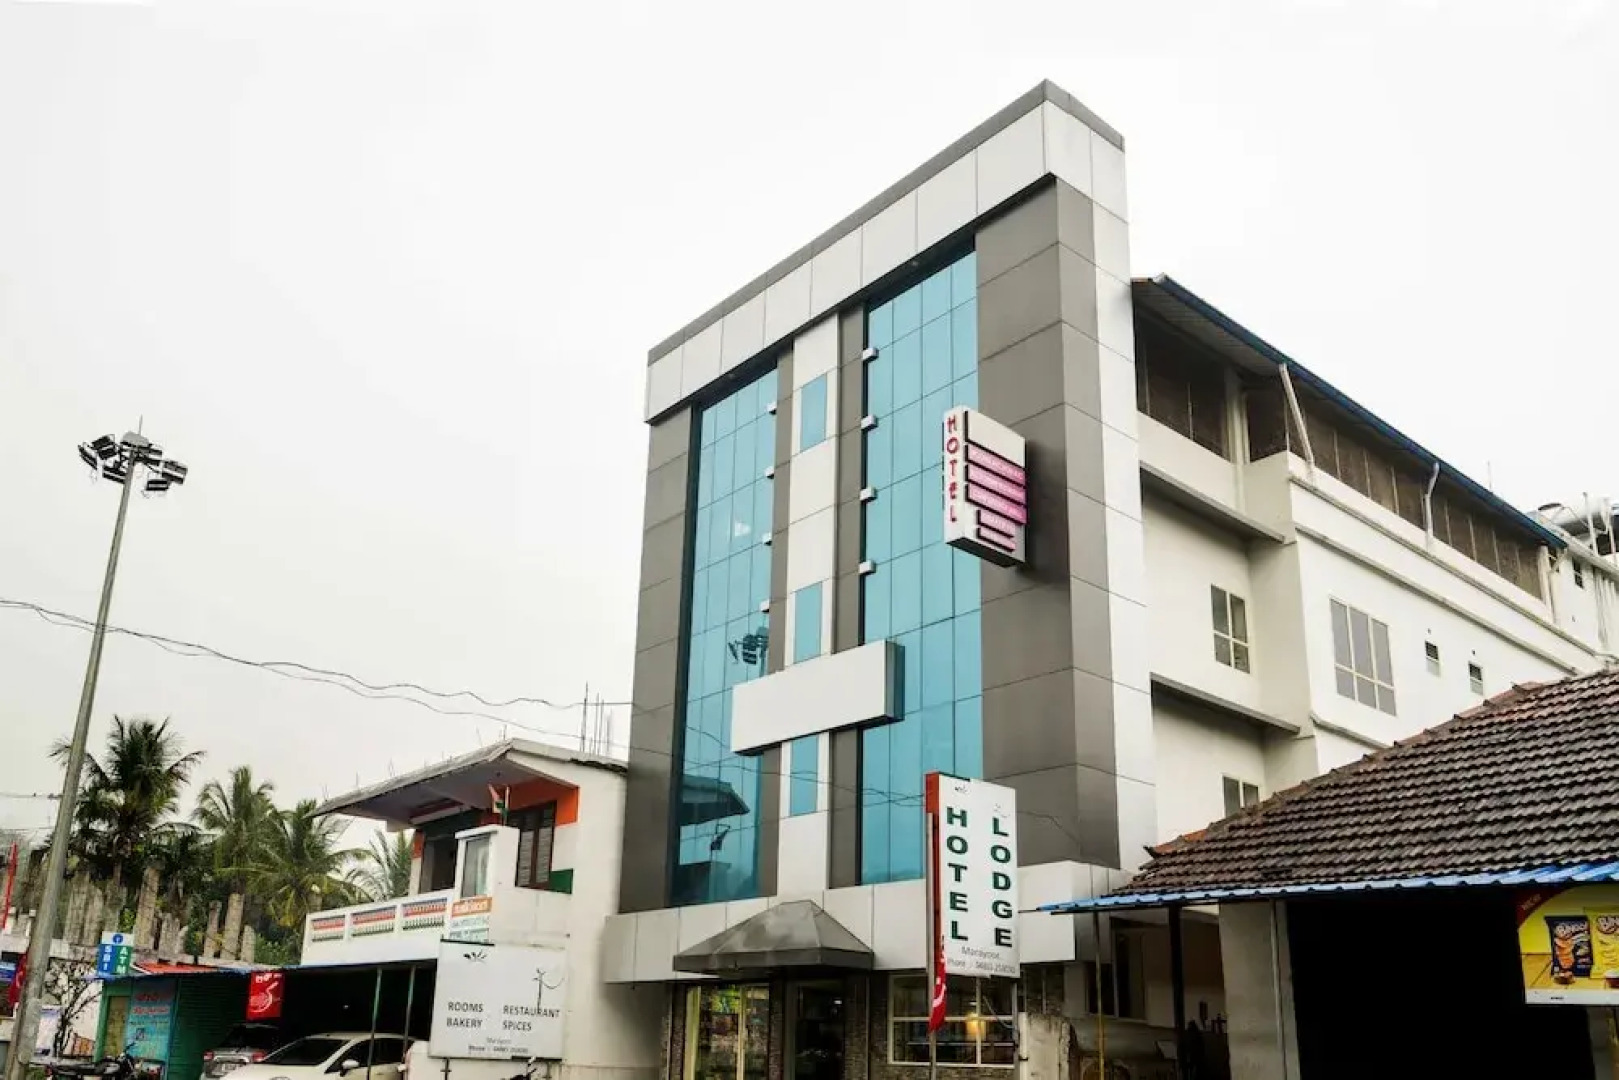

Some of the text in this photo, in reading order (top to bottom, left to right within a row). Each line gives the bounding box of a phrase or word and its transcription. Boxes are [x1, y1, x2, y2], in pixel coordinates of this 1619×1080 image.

[946, 807, 969, 942] HOTEL
[990, 817, 1014, 948] LODGE
[103, 945, 113, 971] SBI
[116, 946, 129, 974] ATM
[447, 1002, 484, 1013] ROOMS
[503, 1005, 560, 1018] RESTAURANT
[446, 1018, 483, 1029] BAKERY
[502, 1019, 532, 1032] SPICES
